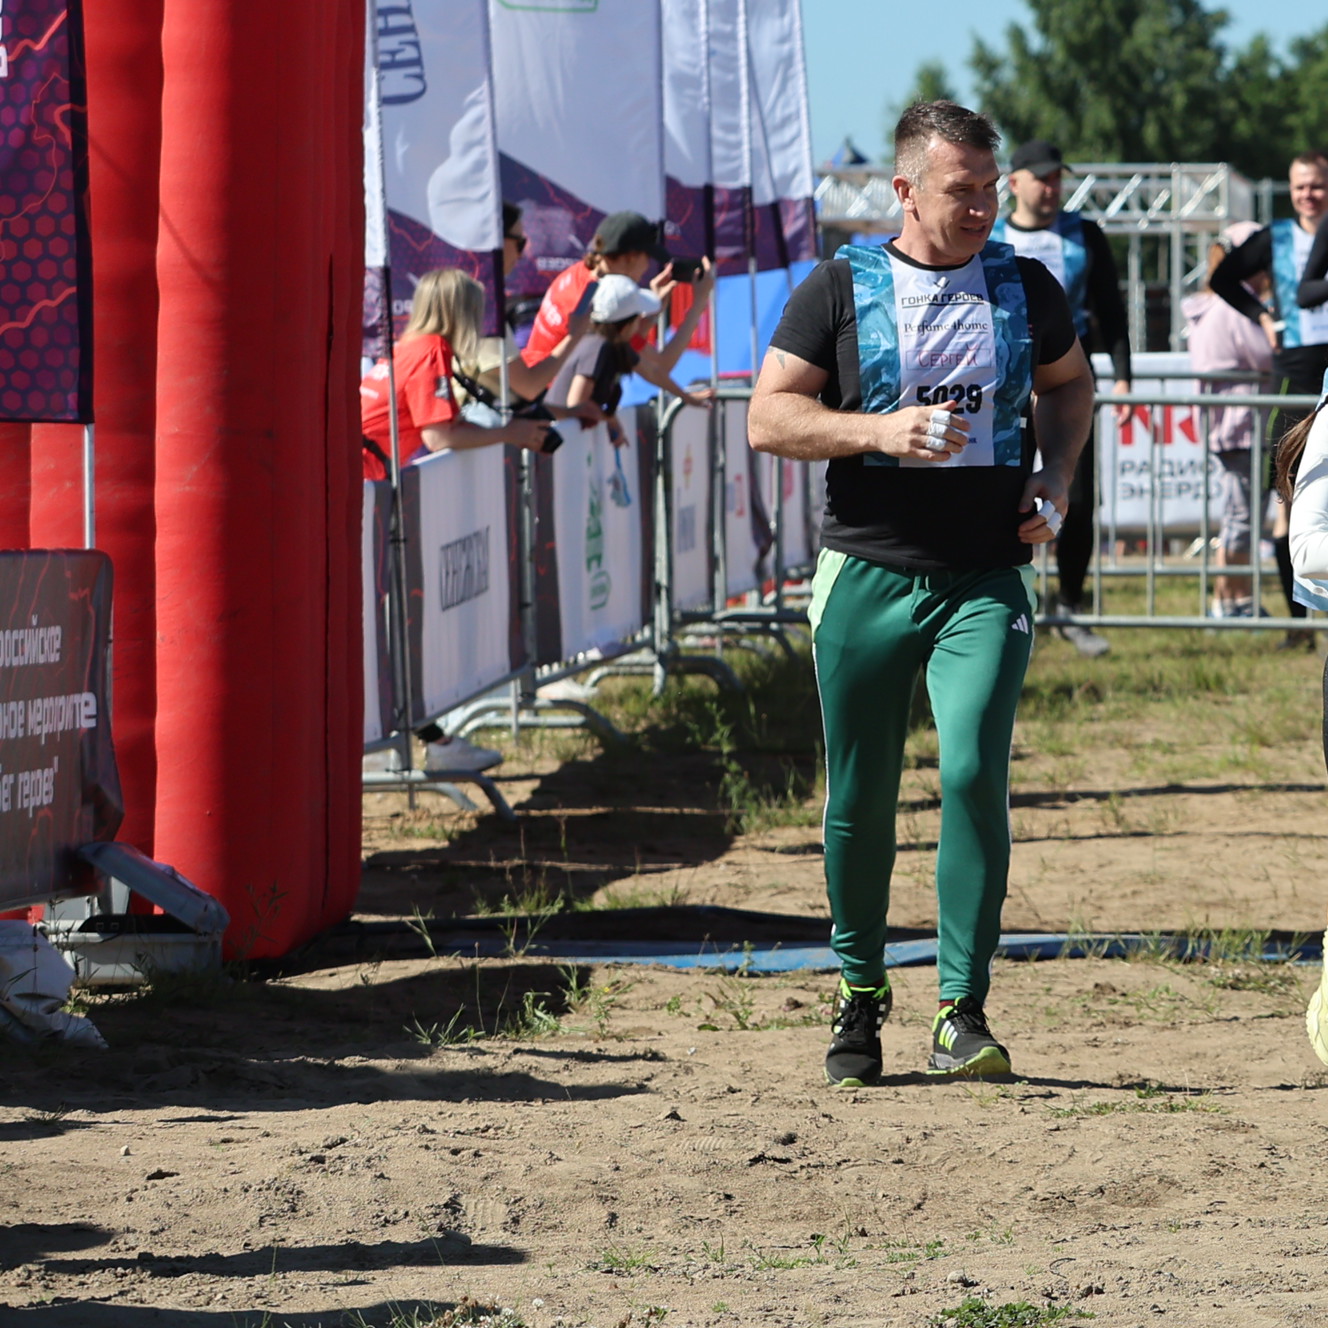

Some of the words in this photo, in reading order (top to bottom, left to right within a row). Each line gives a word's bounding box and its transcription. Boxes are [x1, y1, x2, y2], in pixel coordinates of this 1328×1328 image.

[901, 293, 939, 306] ГОНКА
[941, 292, 984, 303] ГЕРОЕВ
[916, 383, 983, 415] 5029
